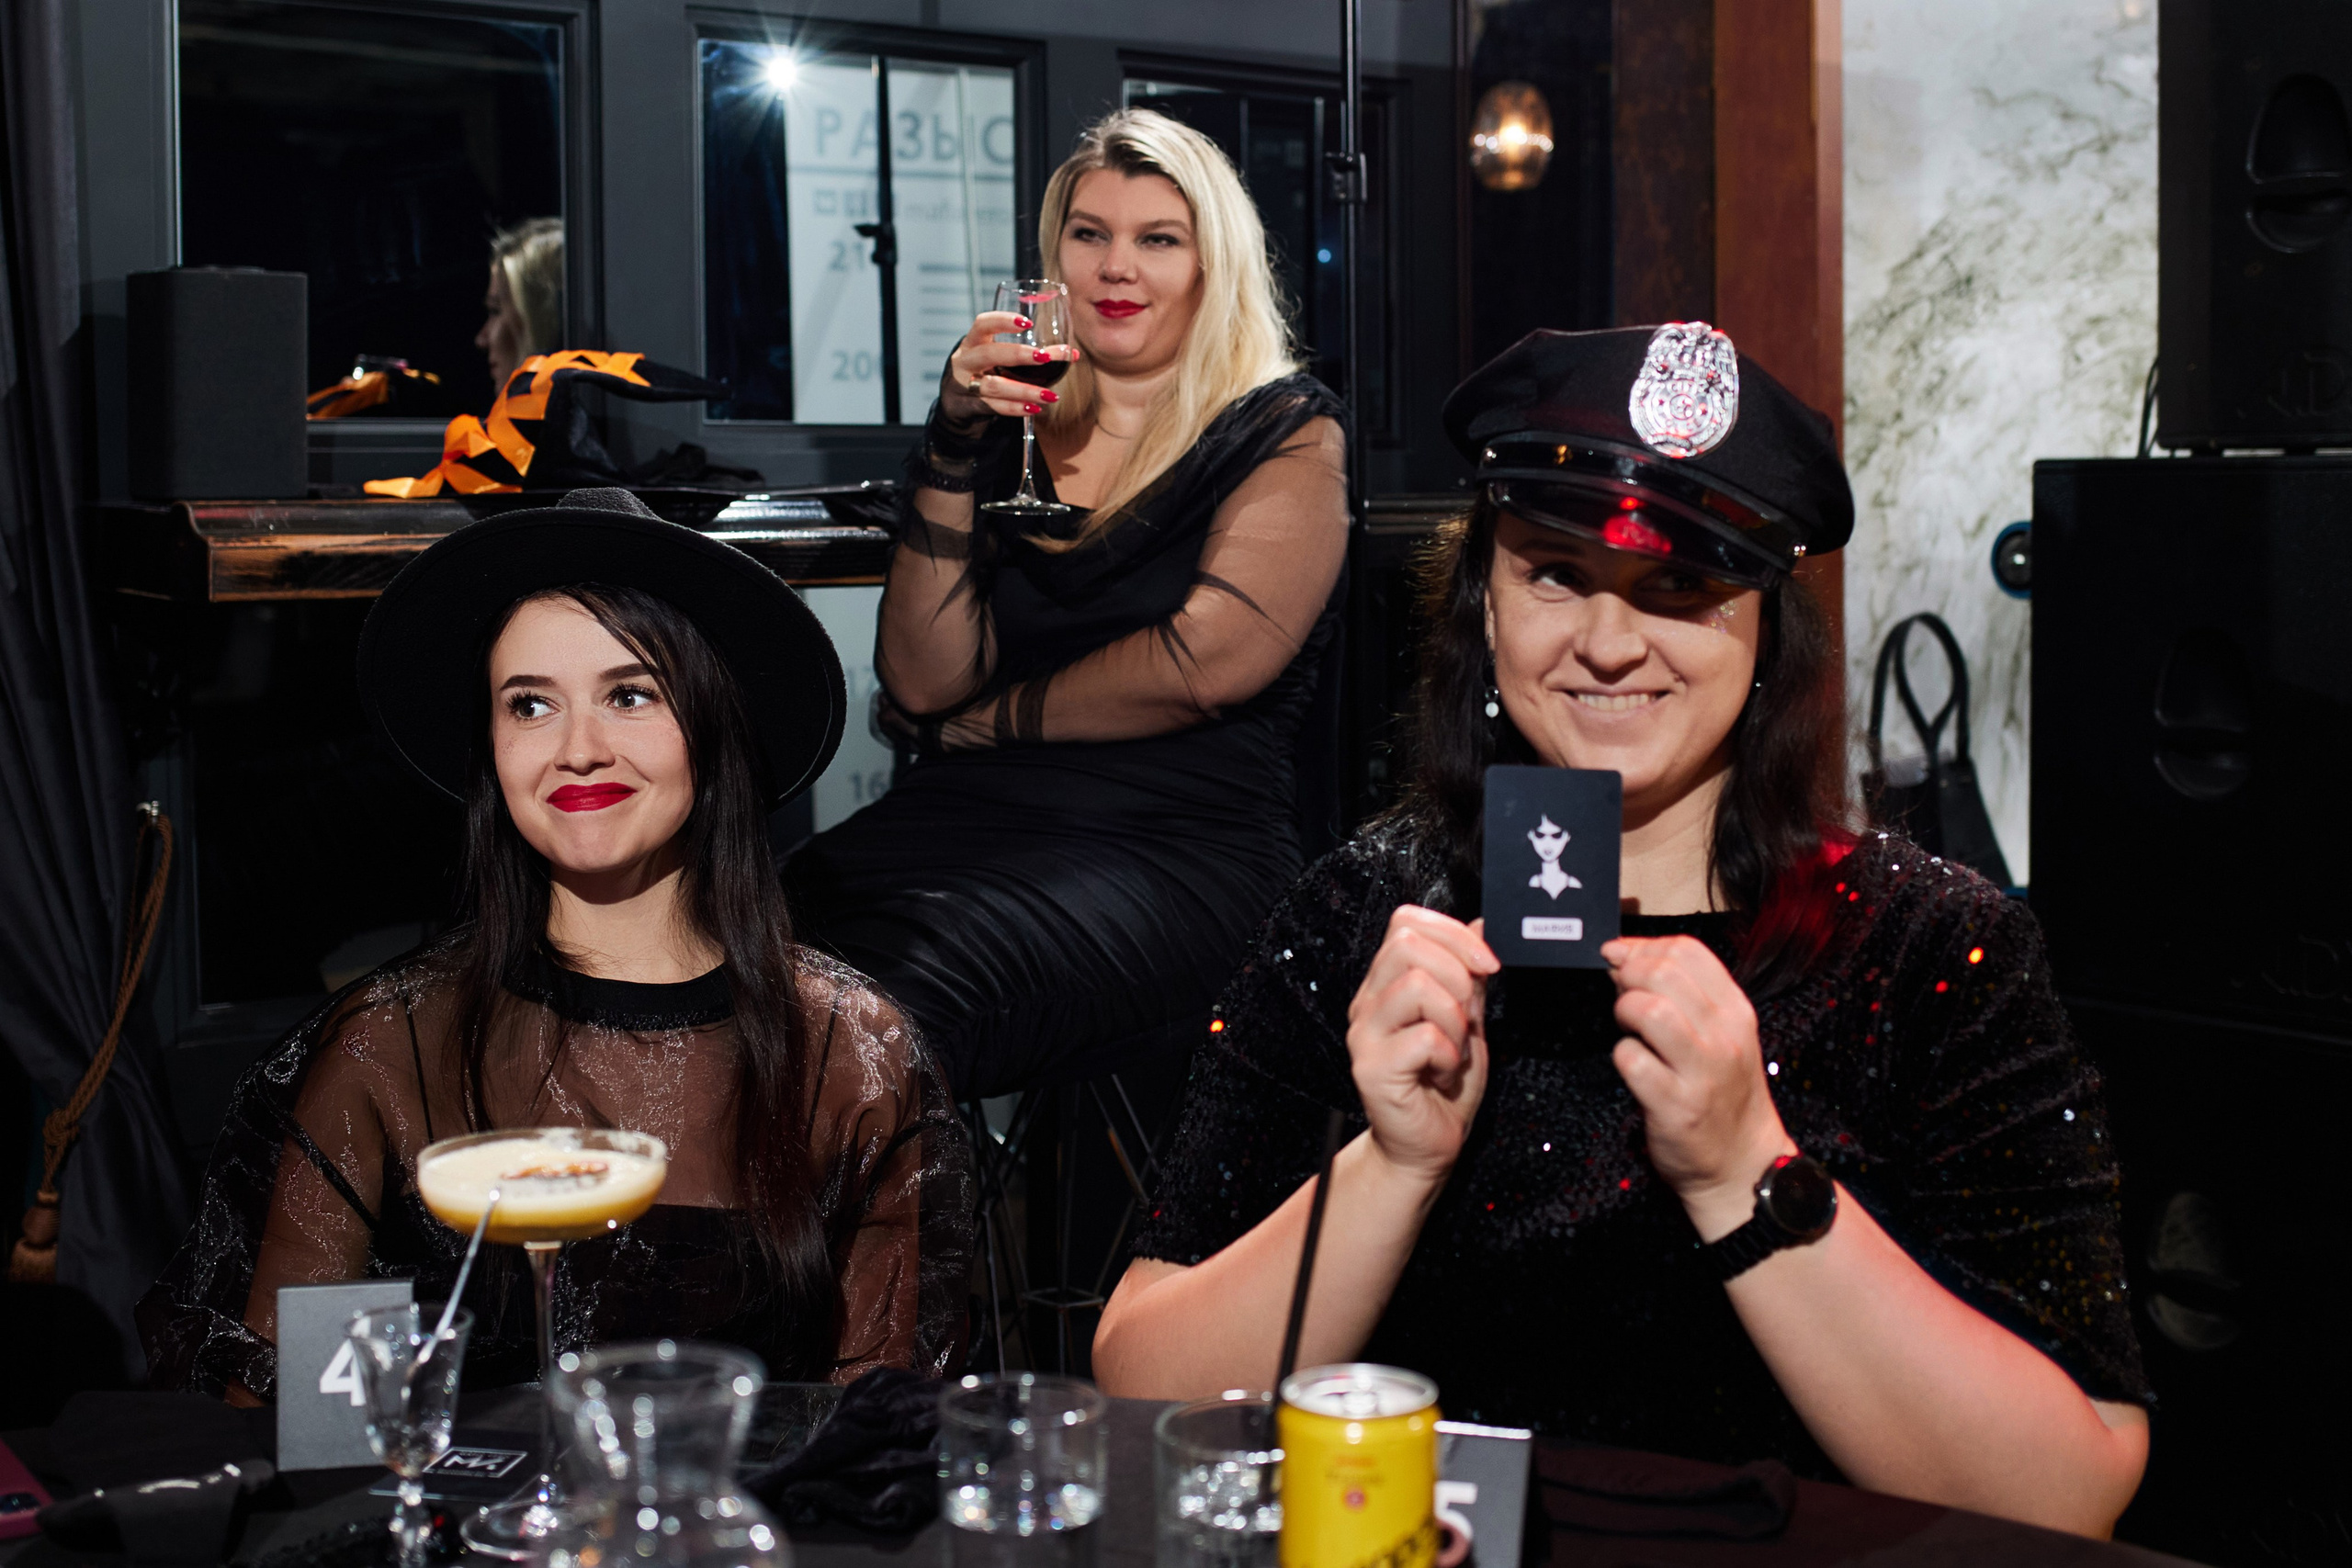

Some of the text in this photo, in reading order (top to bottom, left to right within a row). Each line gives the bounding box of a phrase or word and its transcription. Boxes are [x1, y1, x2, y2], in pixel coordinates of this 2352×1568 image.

[831, 350, 879, 385] 20
[320, 1316, 371, 1406] 4
[1434, 1480, 1477, 1568] 5
